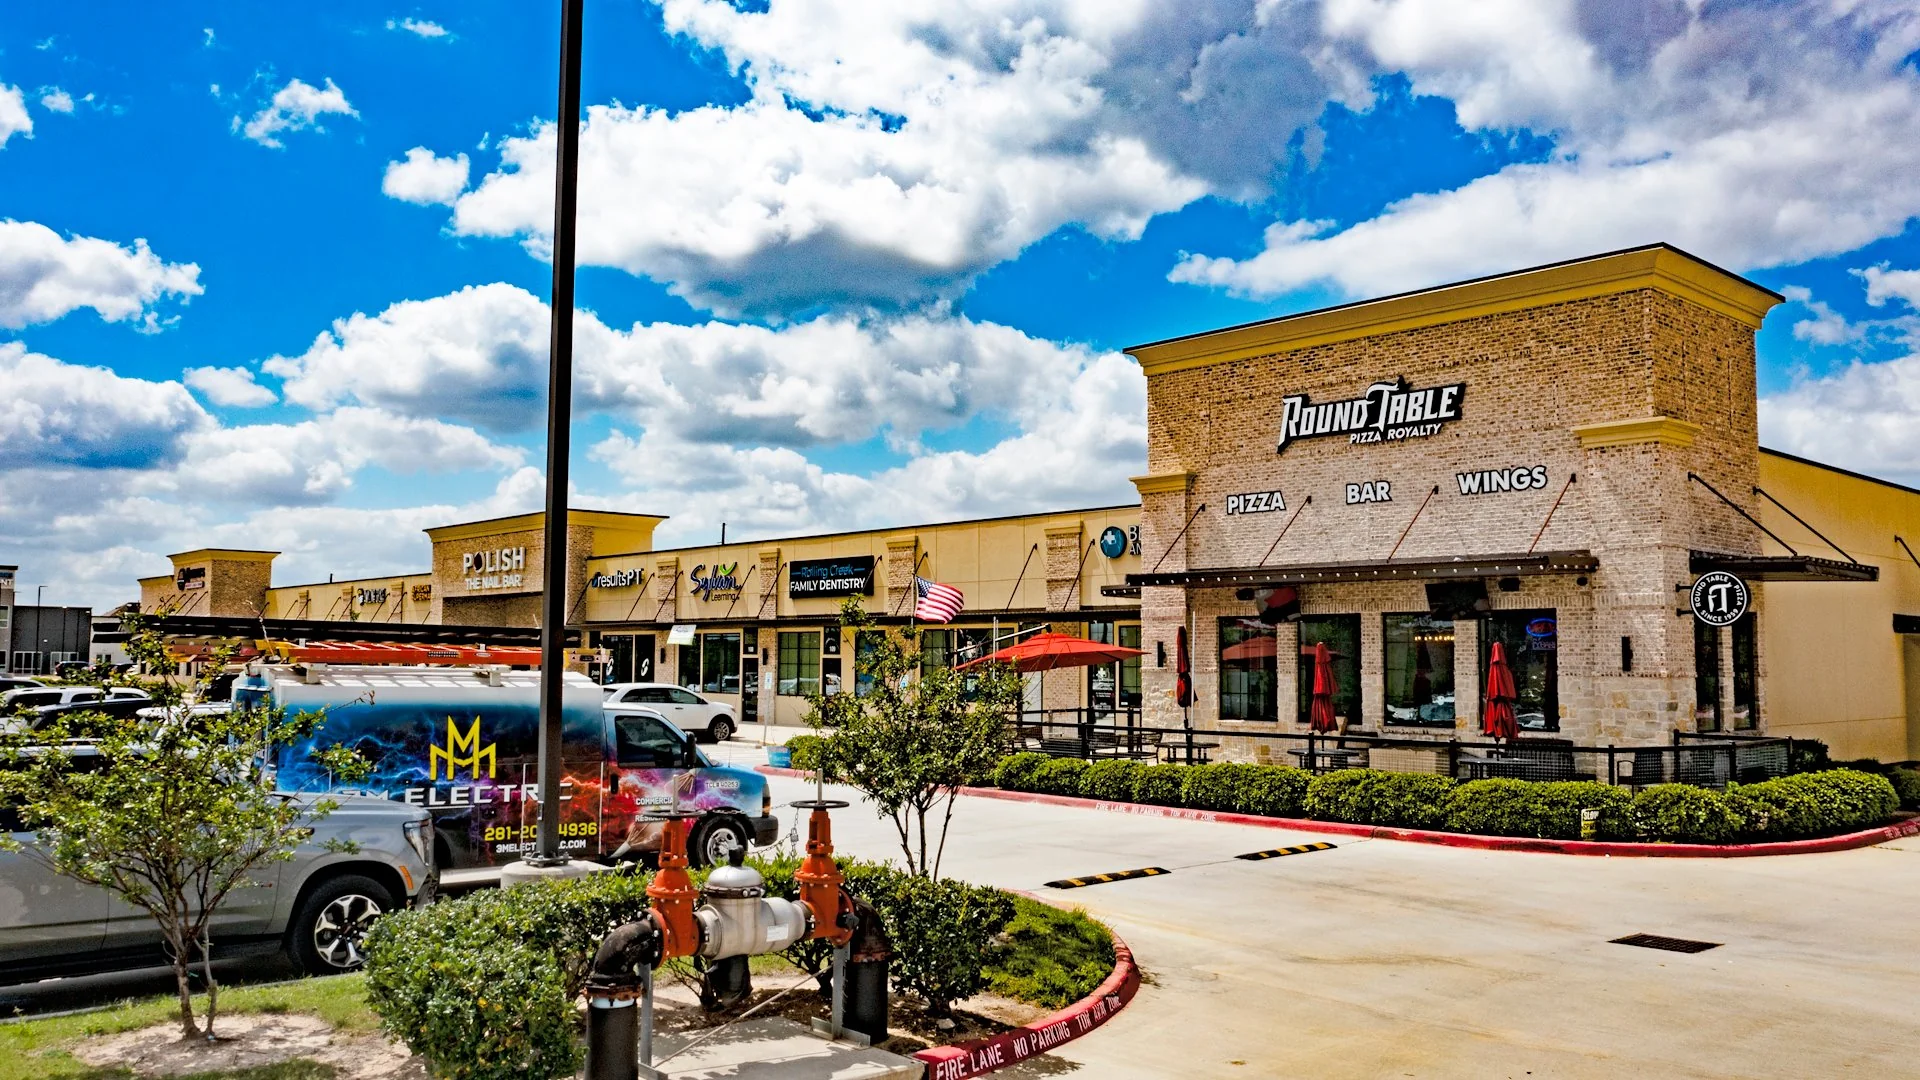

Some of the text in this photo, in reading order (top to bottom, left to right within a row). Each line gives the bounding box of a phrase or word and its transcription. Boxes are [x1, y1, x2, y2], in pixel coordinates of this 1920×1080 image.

[1350, 423, 1442, 445] PIZZA ROYALTY
[1457, 466, 1547, 494] WINGS
[1227, 491, 1286, 514] PIZZA
[1346, 481, 1391, 504] BAR
[463, 546, 526, 575] POLISH
[801, 564, 854, 579] Rolling Creek
[465, 574, 523, 590] THE NAIL BAR
[690, 563, 739, 601] Sylvan
[790, 577, 866, 592] FAMILY DENTISTRY
[1694, 574, 1744, 608] ROUND TABLE PIZZA
[711, 592, 736, 604] Learning
[1700, 608, 1739, 622] SINCE 1959
[405, 782, 573, 806] ELECTRC
[635, 797, 674, 806] COMMERCIA
[1096, 803, 1109, 811] FIRE
[1110, 804, 1127, 813] LANE
[1131, 806, 1139, 814] NO
[1141, 807, 1164, 816] PARKING
[935, 996, 1122, 1080] FIRE LANE NO PARKING TOW AWAY ZONE
